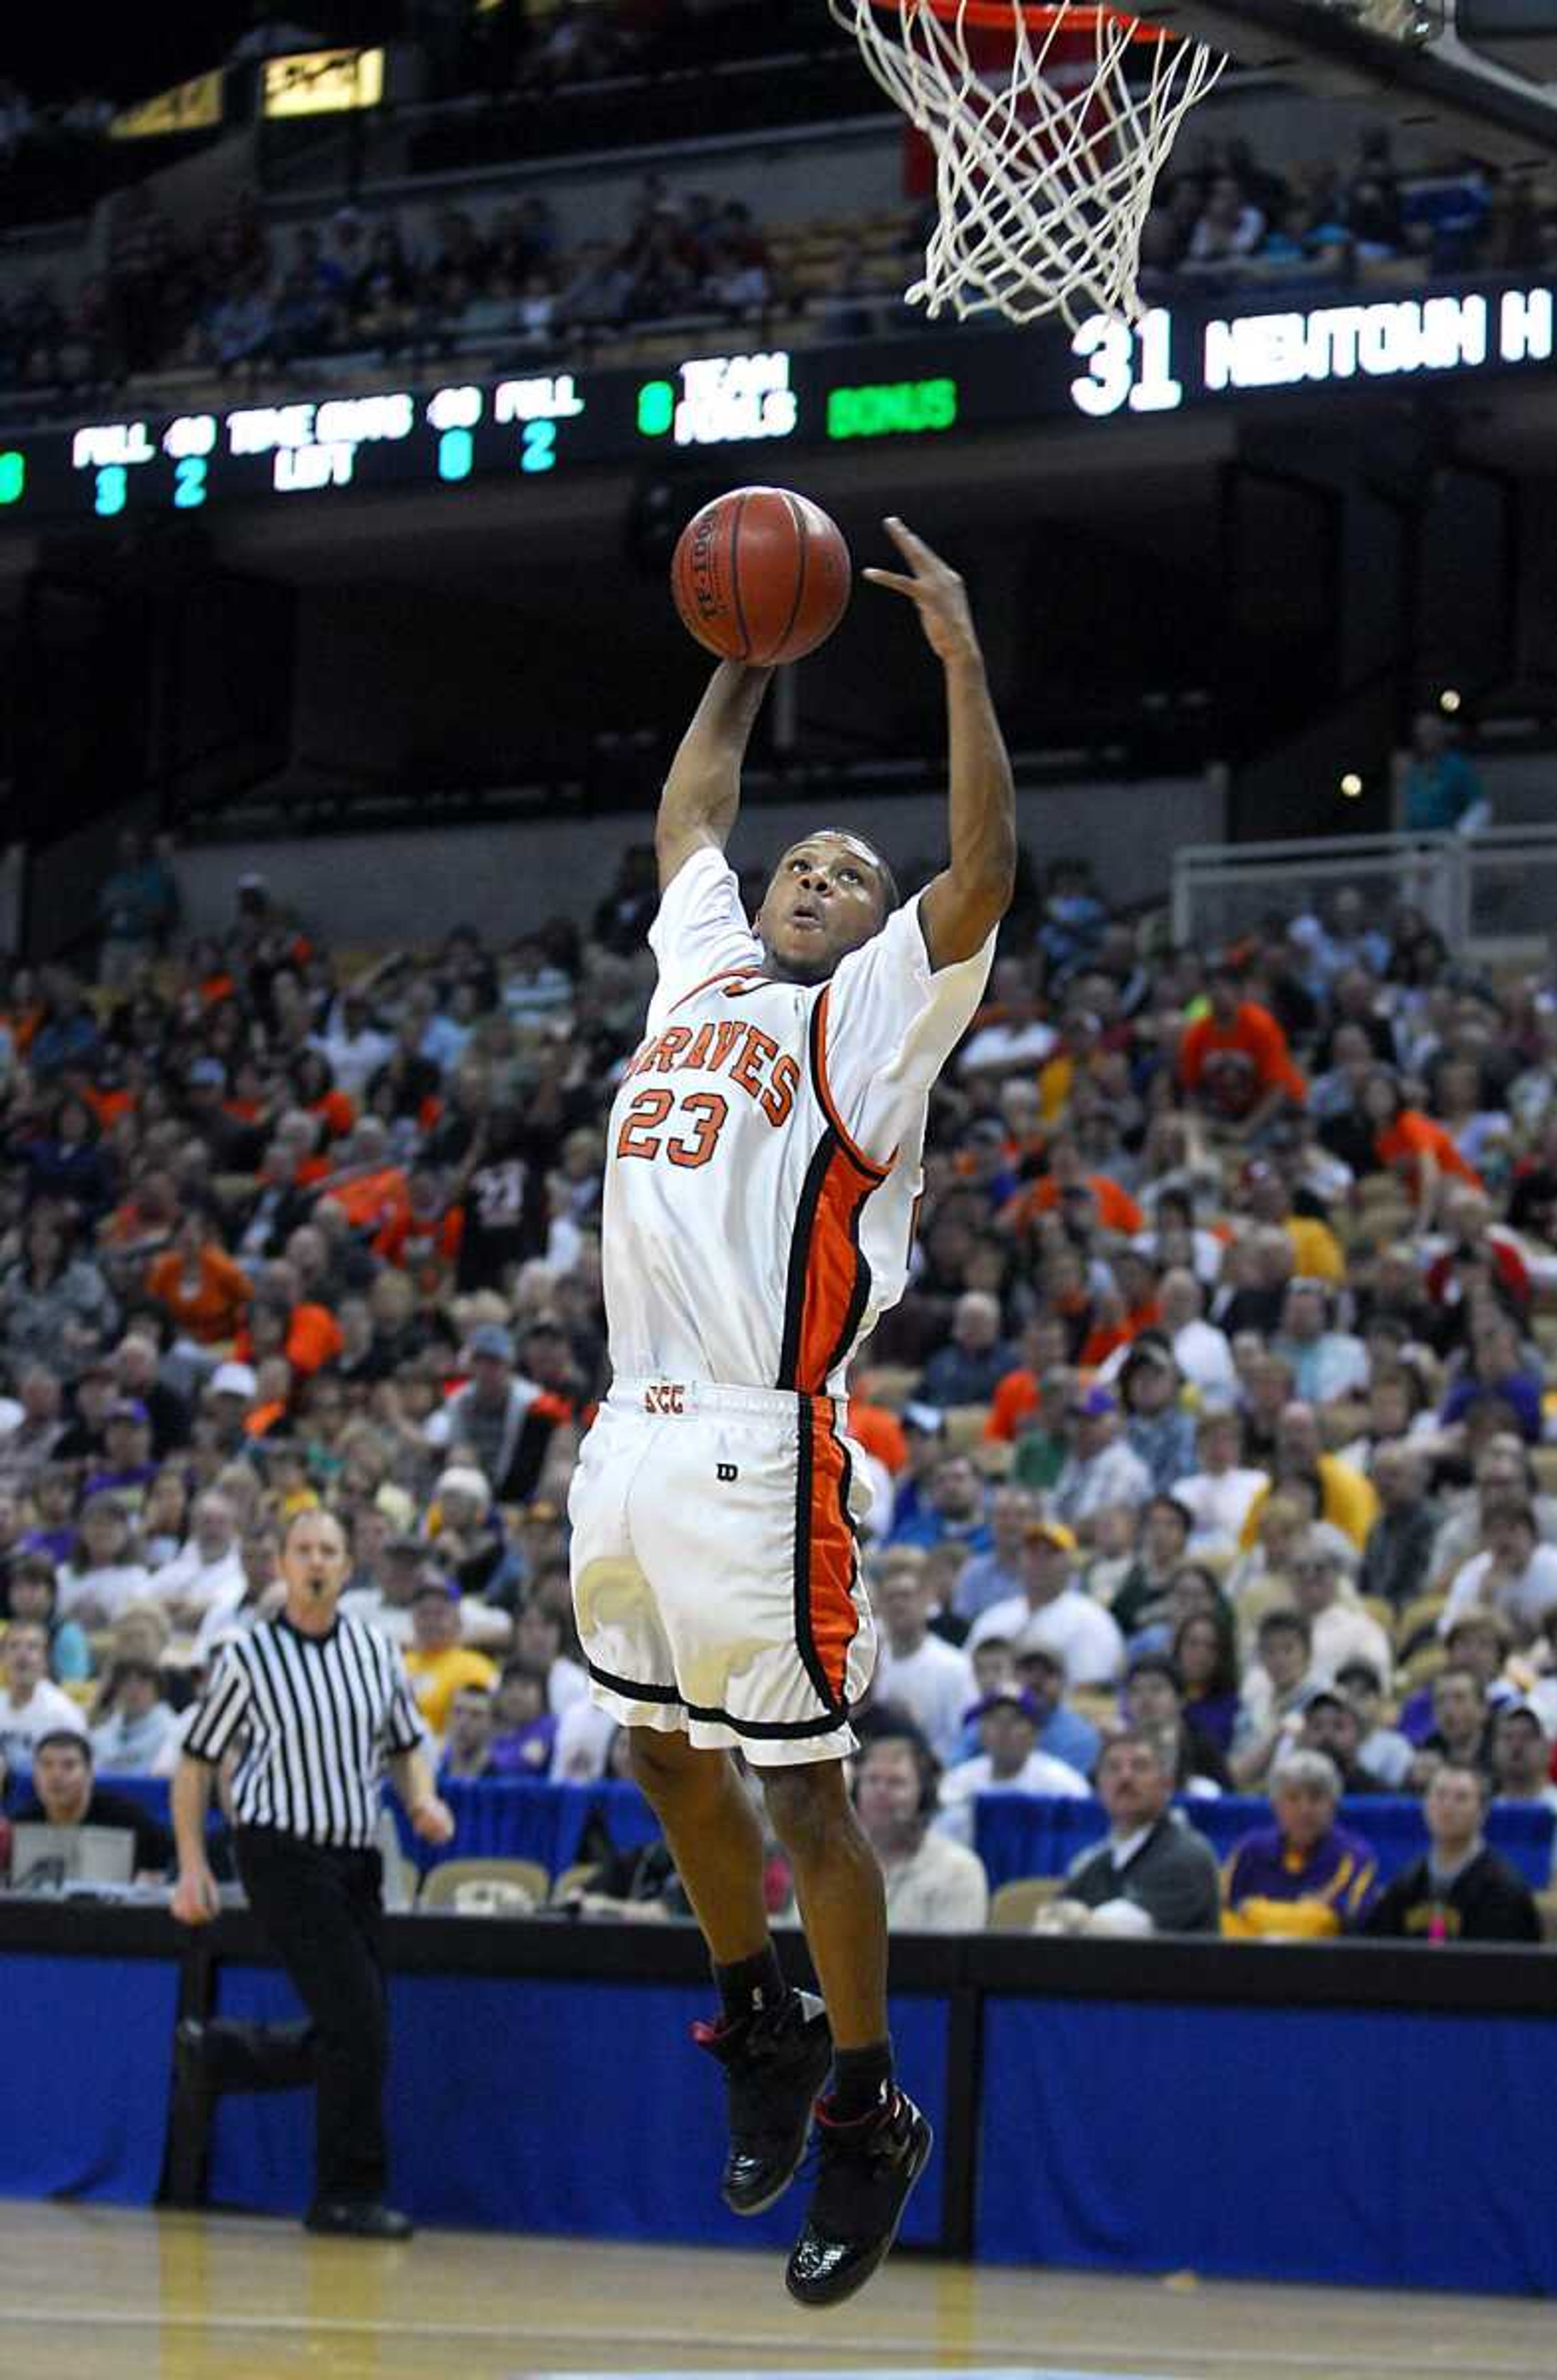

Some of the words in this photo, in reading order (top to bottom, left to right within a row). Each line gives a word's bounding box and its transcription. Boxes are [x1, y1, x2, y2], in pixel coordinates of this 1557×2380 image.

[681, 352, 788, 401] TEAM
[1071, 308, 1182, 415] 31
[1204, 295, 1486, 389] NEWTOWN
[1501, 289, 1552, 361] H
[495, 375, 583, 422] FULL
[675, 390, 796, 444] FOULS
[829, 380, 955, 437] BONUS
[74, 423, 154, 467] FULL
[522, 420, 555, 471] 2
[175, 457, 206, 508] 2
[617, 1088, 729, 1169] 23
